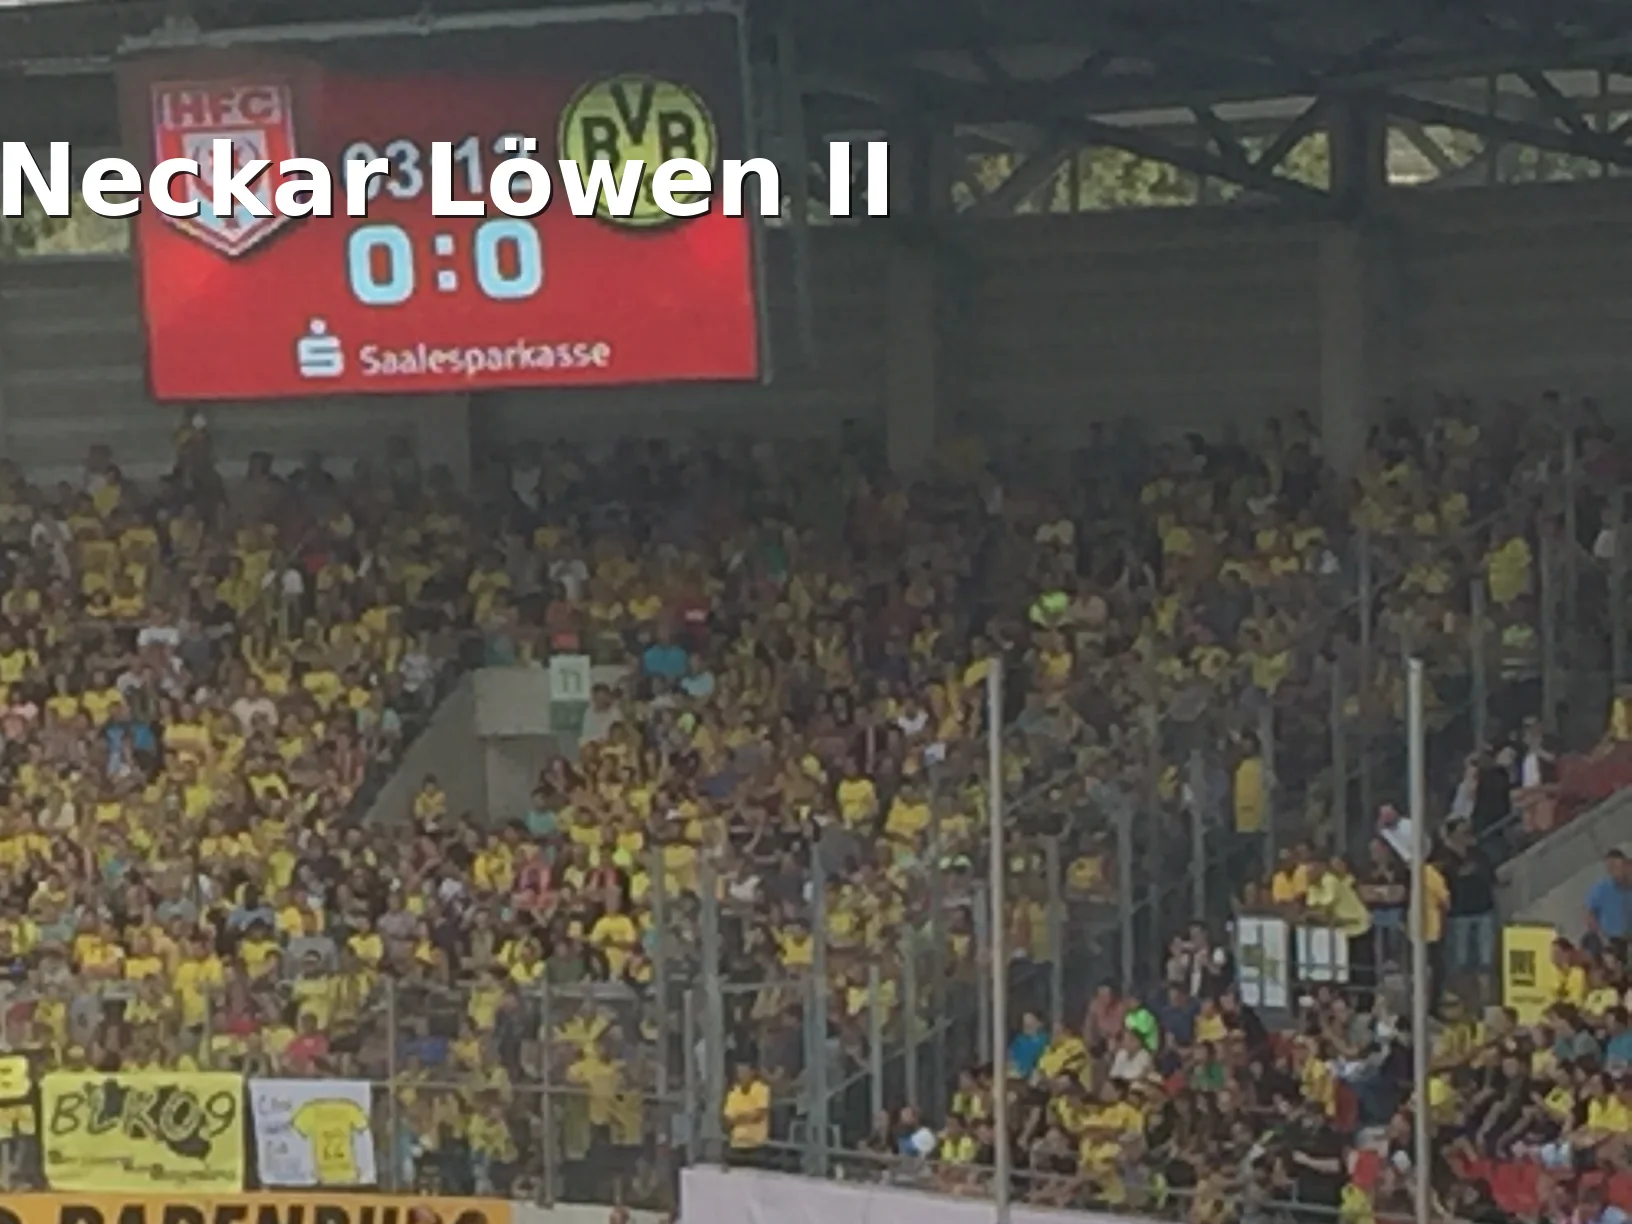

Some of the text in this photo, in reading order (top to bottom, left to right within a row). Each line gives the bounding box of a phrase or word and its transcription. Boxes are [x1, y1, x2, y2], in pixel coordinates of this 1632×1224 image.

[167, 87, 277, 128] HFC
[581, 78, 695, 172] BVB
[348, 218, 544, 304] 0:0
[358, 337, 611, 381] Saalesparkasse
